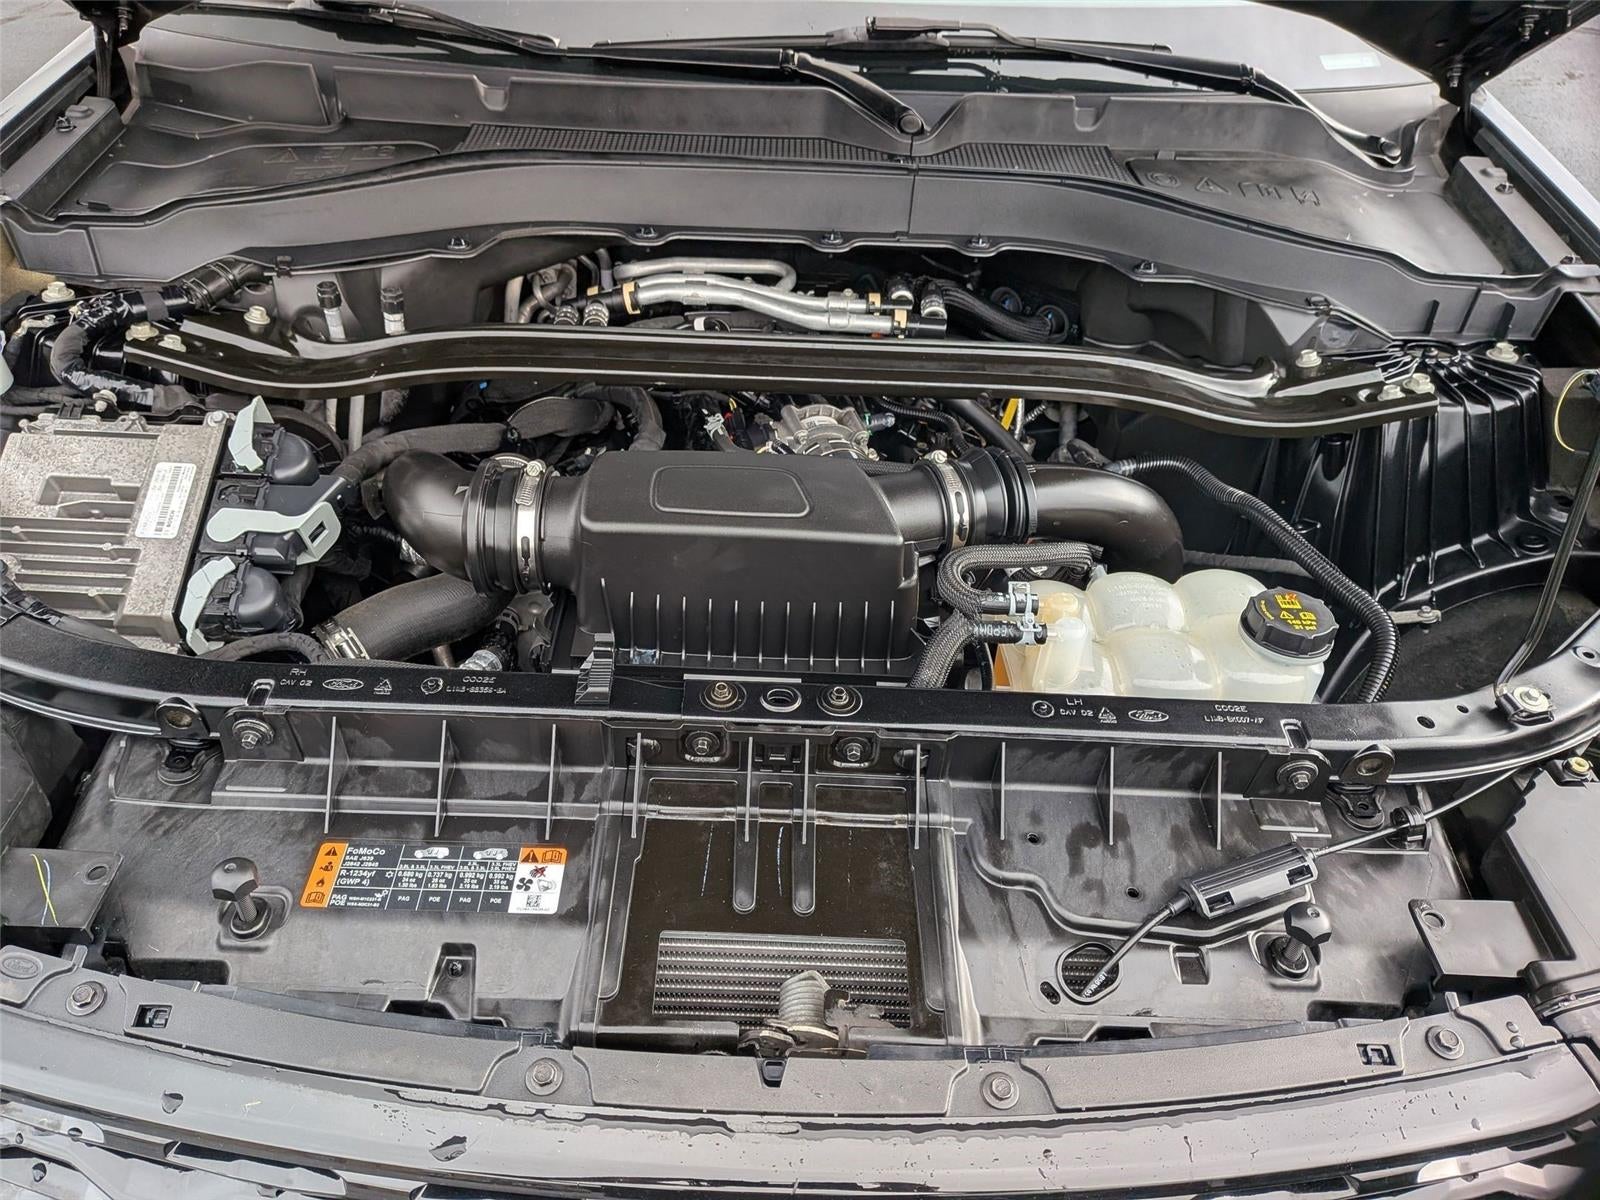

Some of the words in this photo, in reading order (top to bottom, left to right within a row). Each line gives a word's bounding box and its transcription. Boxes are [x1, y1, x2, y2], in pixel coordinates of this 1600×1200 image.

[1066, 698, 1083, 706] LH
[346, 847, 386, 856] FoMoCo
[339, 869, 377, 878] R-1234yf
[415, 871, 424, 879] kg
[444, 872, 453, 880] kg
[505, 873, 514, 881] kg
